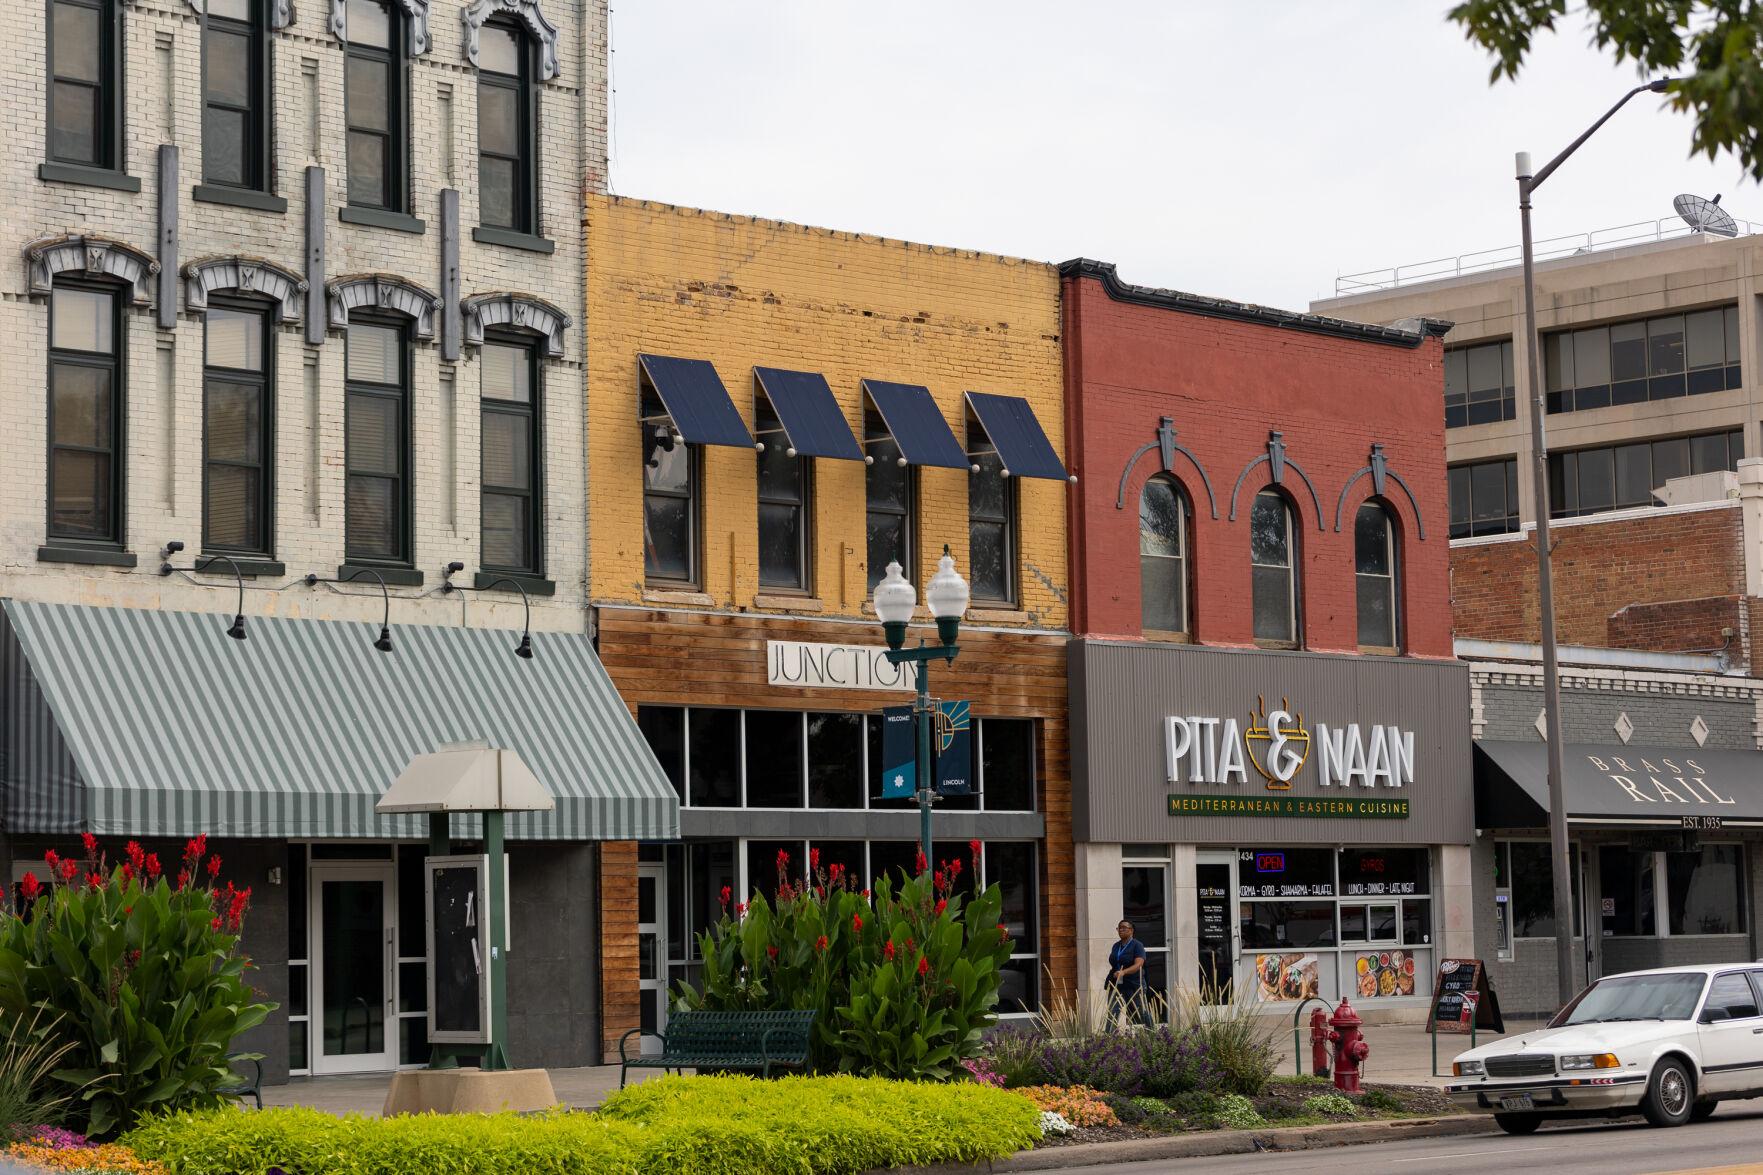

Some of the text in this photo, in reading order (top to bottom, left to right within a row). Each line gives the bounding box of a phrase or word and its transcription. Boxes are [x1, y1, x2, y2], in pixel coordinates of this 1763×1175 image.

[1165, 711, 1414, 787] PITA & NAAN
[1588, 756, 1705, 774] BRASS
[1609, 775, 1735, 804] RAIL
[1172, 799, 1408, 814] MEDITERRANEAN & EASTERN CUISINE
[1682, 816, 1721, 829] EST. 1935
[1258, 856, 1284, 870] OPEN
[1261, 885, 1275, 896] GYRO
[1280, 885, 1308, 896] SHAWARMA
[1312, 884, 1333, 896] FALAFEL
[1348, 884, 1364, 895] LUNCH
[1368, 883, 1385, 894] DINNER
[1389, 883, 1401, 894] LATE
